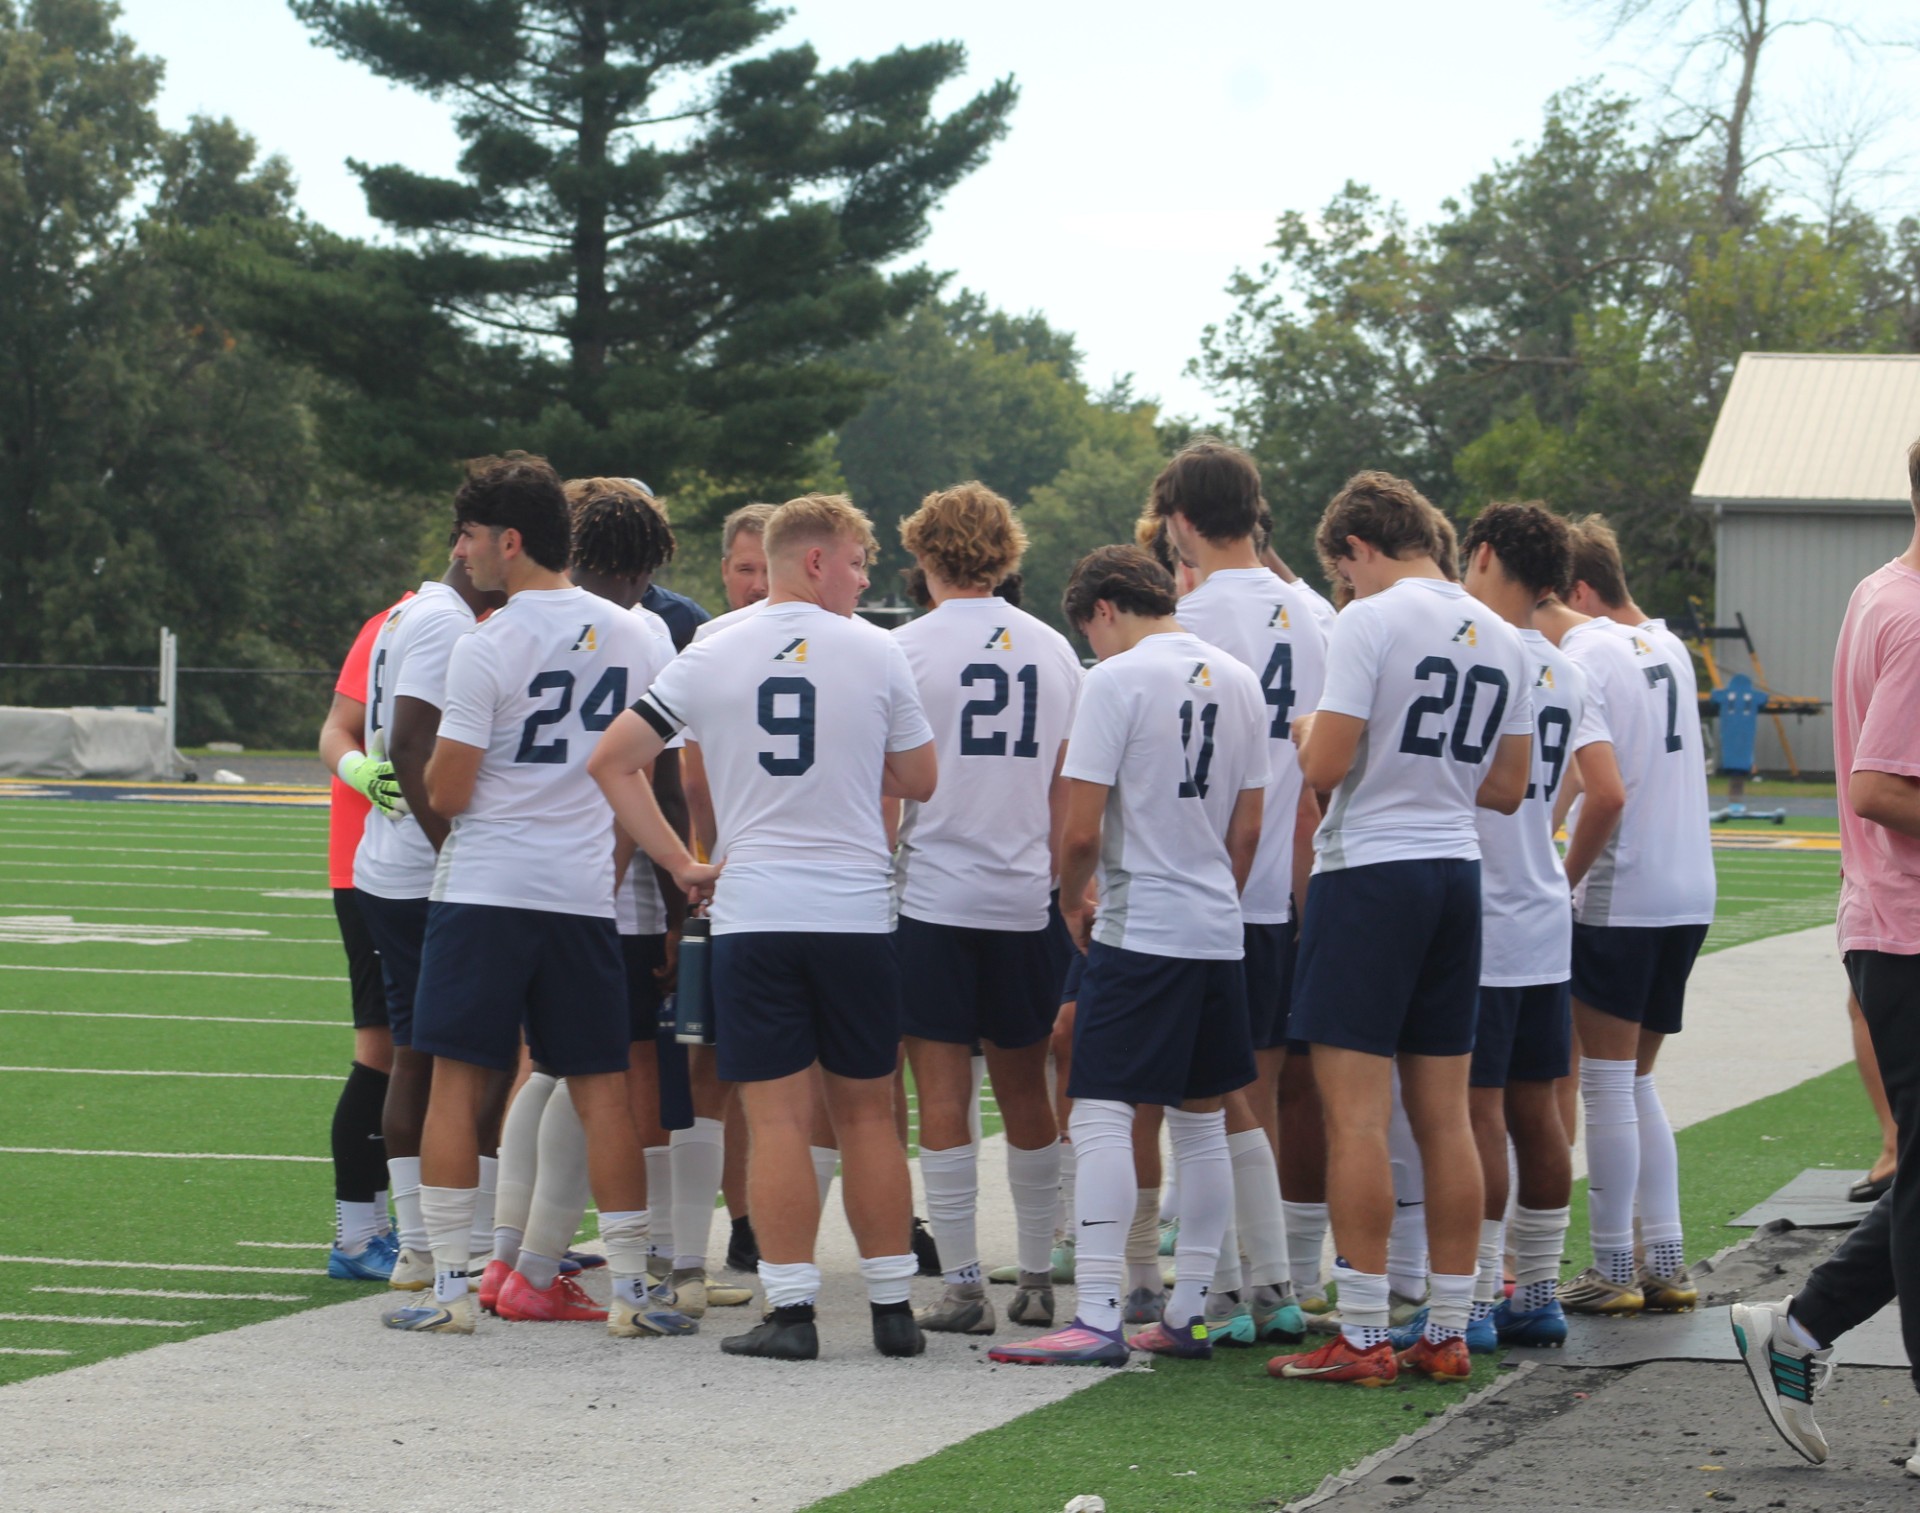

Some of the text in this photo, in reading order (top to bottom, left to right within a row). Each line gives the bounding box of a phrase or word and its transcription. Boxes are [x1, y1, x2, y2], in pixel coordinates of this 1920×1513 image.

[570, 624, 597, 651] A
[772, 637, 808, 662] A
[985, 627, 1013, 650] A
[1267, 604, 1291, 629] A
[1451, 620, 1477, 647] A
[514, 666, 628, 764] 24
[960, 663, 1039, 758] 21
[1187, 662, 1212, 686] A
[1261, 643, 1296, 739] 4
[1398, 656, 1509, 764] 20
[1535, 665, 1555, 688] A
[1642, 663, 1682, 753] 7
[757, 676, 816, 776] 9
[1178, 700, 1219, 799] 11
[1524, 705, 1572, 802] 9
